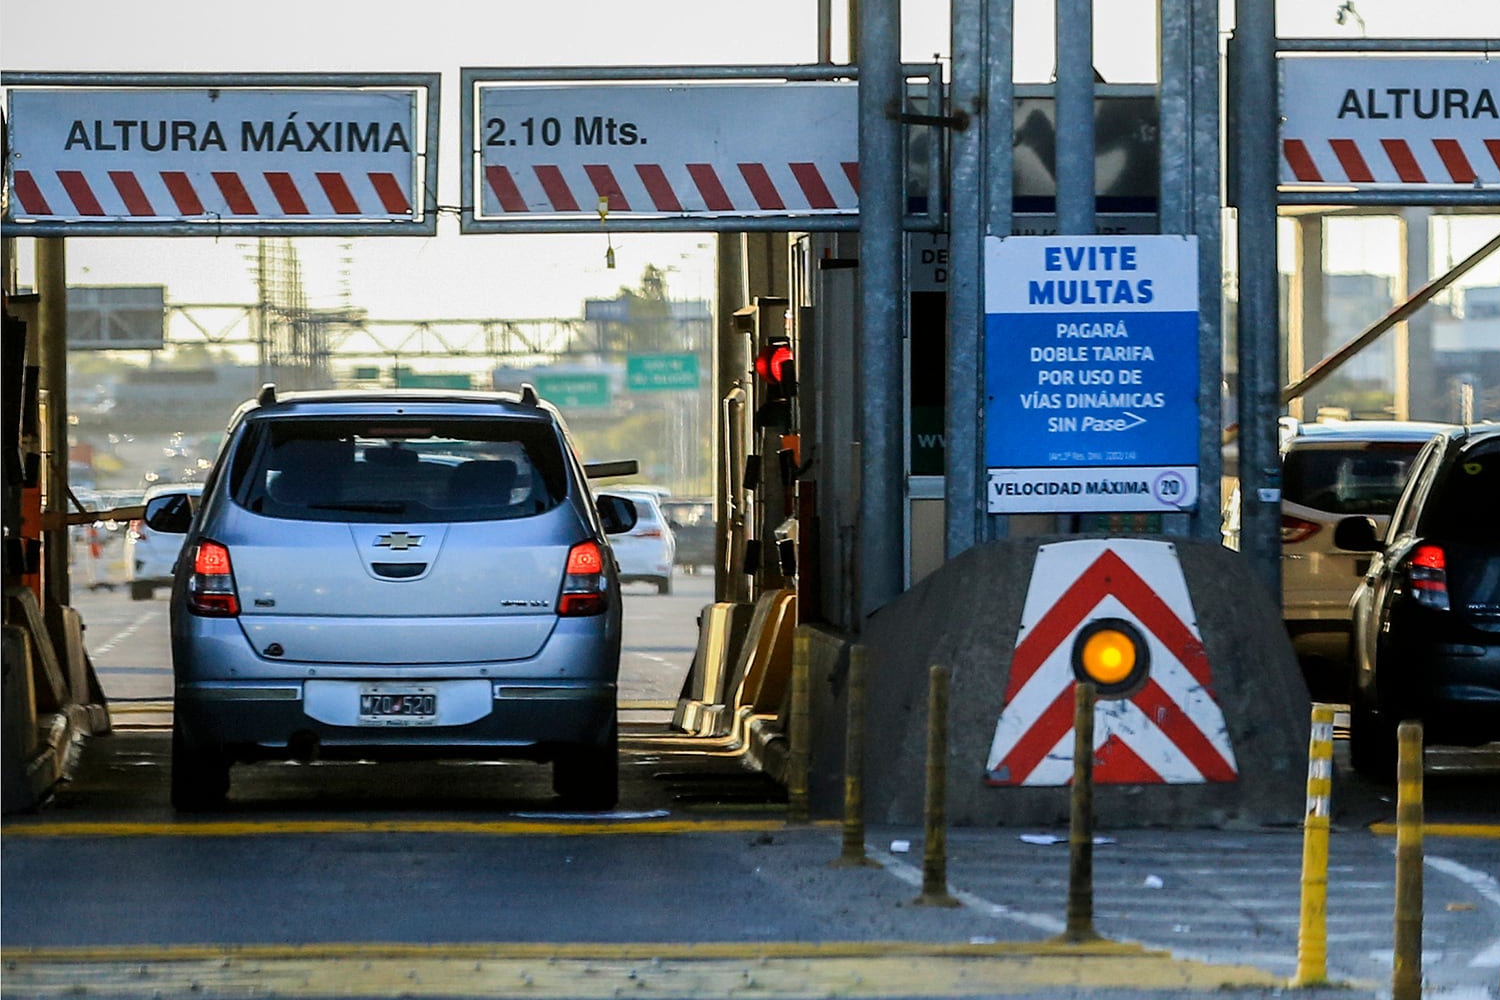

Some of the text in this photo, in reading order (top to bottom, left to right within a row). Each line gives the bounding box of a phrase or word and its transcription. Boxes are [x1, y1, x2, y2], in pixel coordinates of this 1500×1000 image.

[1337, 88, 1500, 120] ALTURA
[64, 112, 411, 154] ALTURA MÁXIMA
[486, 116, 648, 148] 2.10 Mts.
[1044, 246, 1137, 272] EVITE
[1028, 279, 1154, 305] MULTAS
[1056, 320, 1129, 339] PAGARÁ
[1030, 345, 1155, 363] DOBLE TARIFA
[1038, 369, 1143, 386] POR USO DE
[1020, 390, 1166, 409] VÍAS DINÁMICAS
[1048, 416, 1128, 433] SIN Pase
[994, 478, 1180, 496] VELOCIDAD MÁXIMA 20
